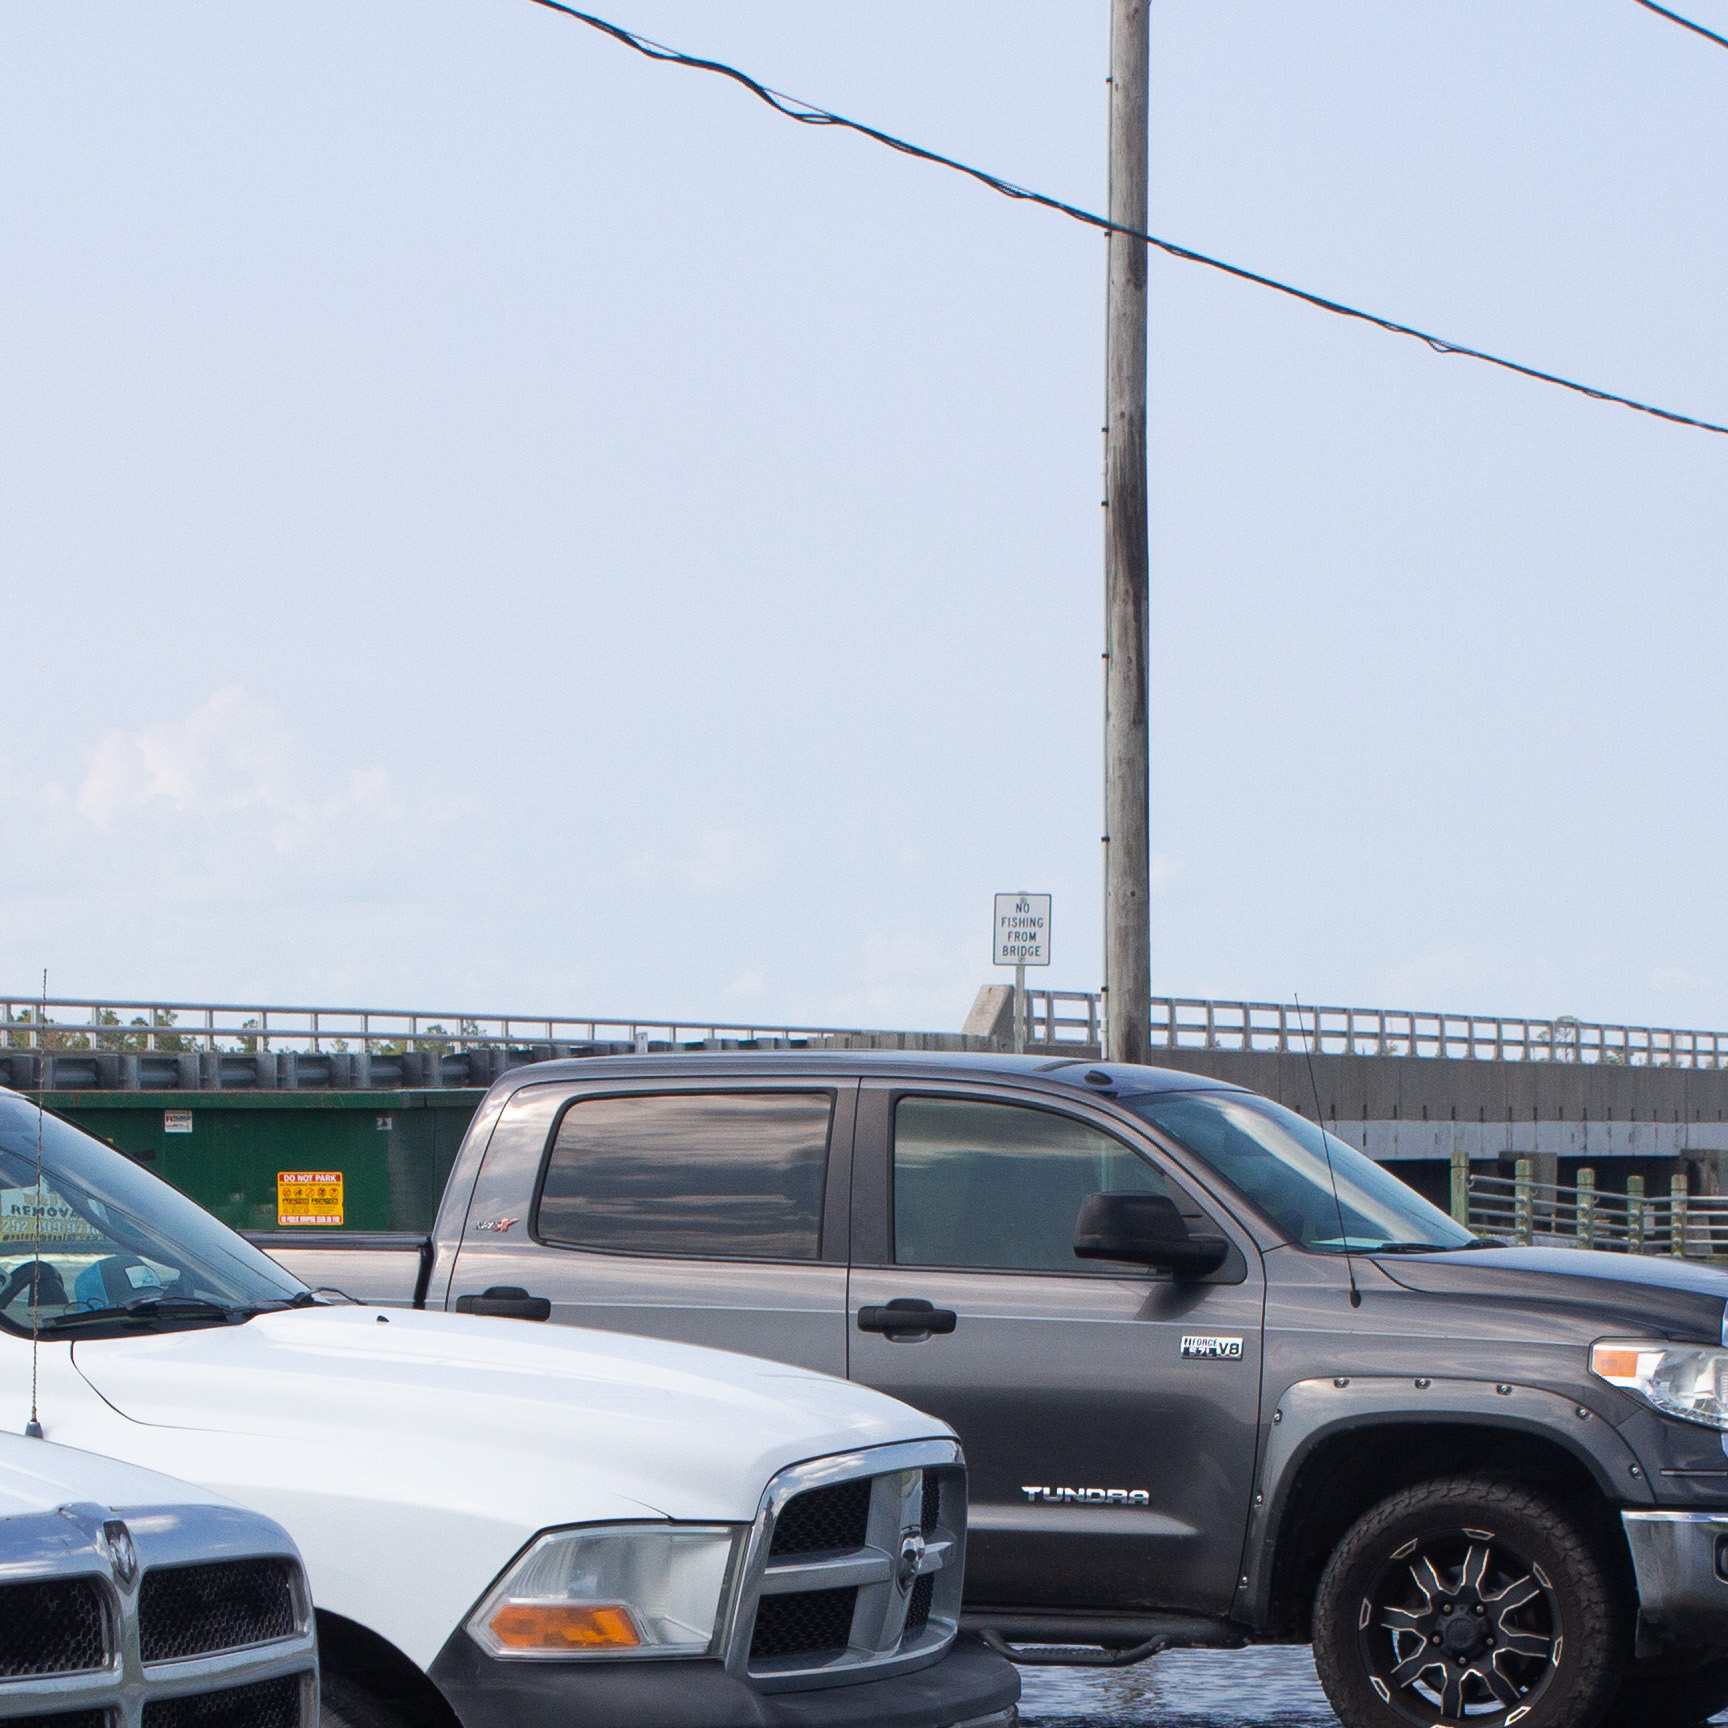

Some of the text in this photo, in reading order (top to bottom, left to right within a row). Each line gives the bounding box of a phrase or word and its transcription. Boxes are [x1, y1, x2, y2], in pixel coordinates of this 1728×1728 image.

[1015, 903, 1030, 913] NO
[1001, 917, 1044, 928] FISHING
[1007, 931, 1037, 942] FROM
[1002, 945, 1042, 957] BRIDGE
[1218, 1342, 1240, 1355] V8
[1021, 1486, 1150, 1505] TUNDRA
